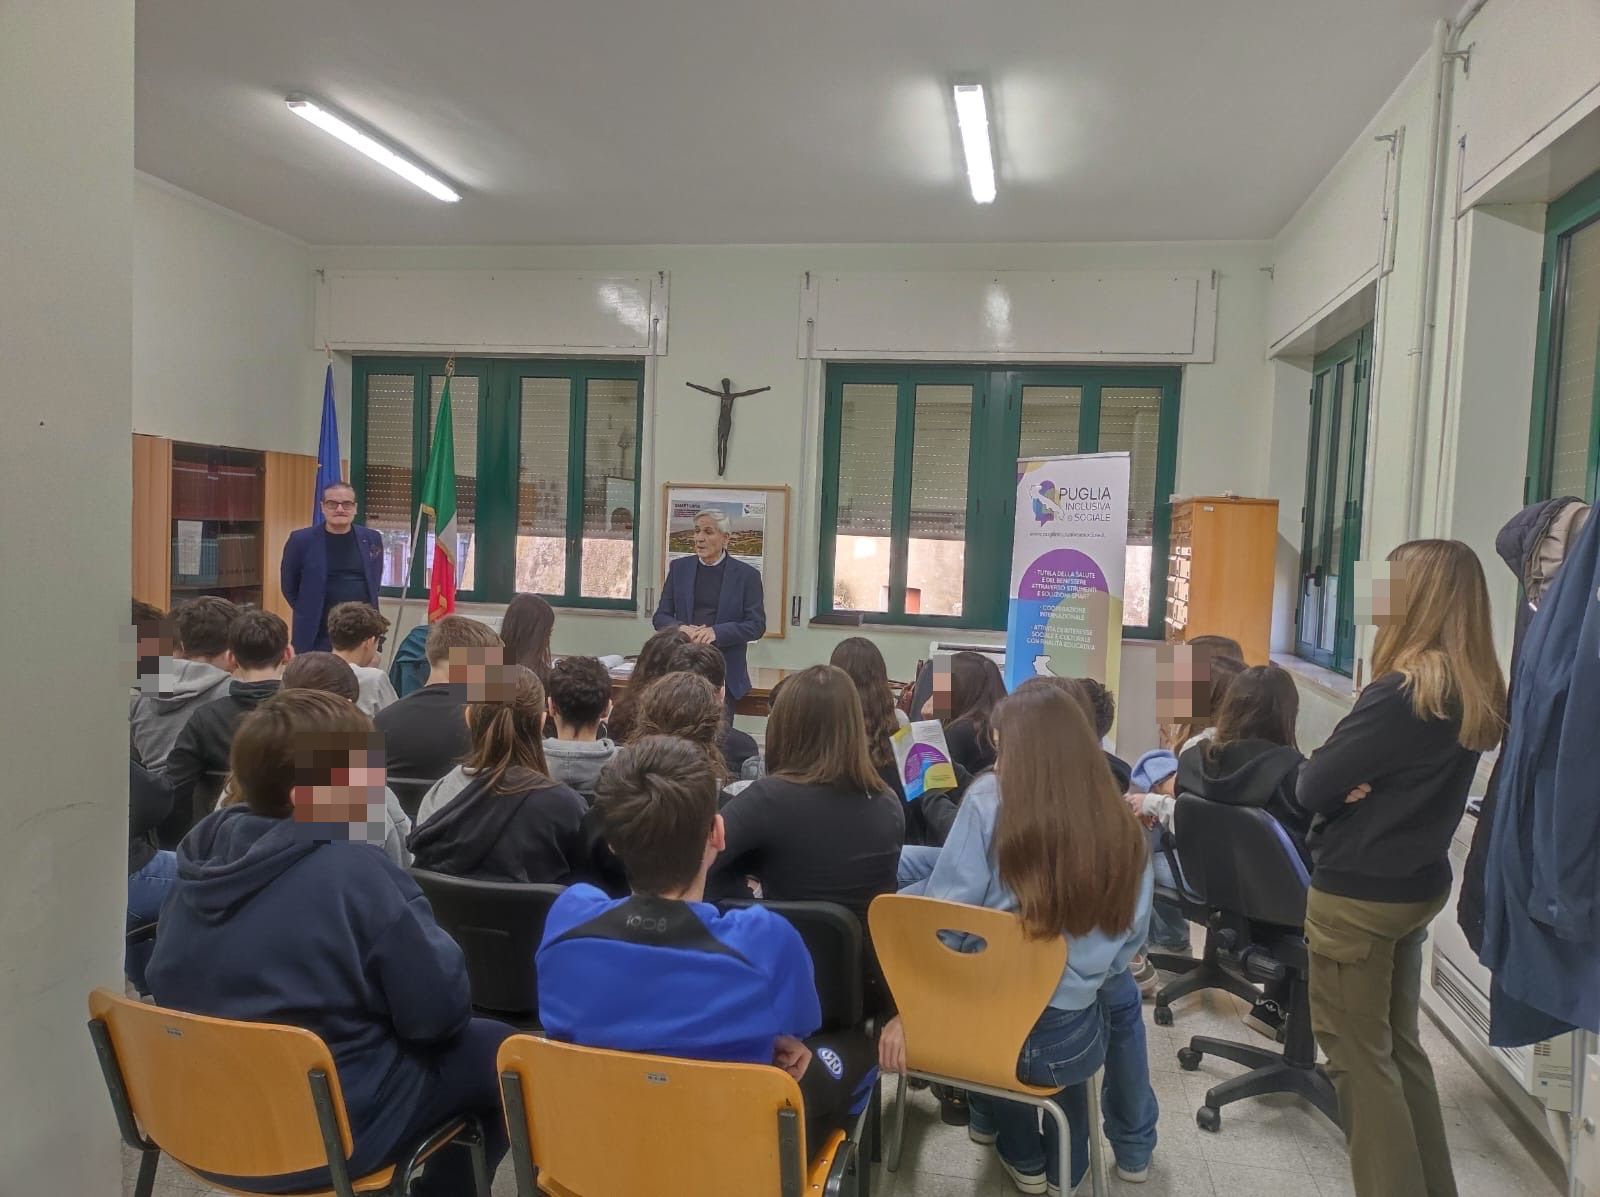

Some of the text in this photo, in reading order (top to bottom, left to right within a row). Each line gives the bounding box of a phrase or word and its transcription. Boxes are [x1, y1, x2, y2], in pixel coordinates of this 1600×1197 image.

[1060, 487, 1111, 500] PUGLIA
[1065, 502, 1111, 511] INCLUSIVA
[1074, 514, 1111, 522] SOCIALE
[1075, 571, 1096, 579] SALUTE
[1040, 612, 1085, 620] INTERNAZIONALE
